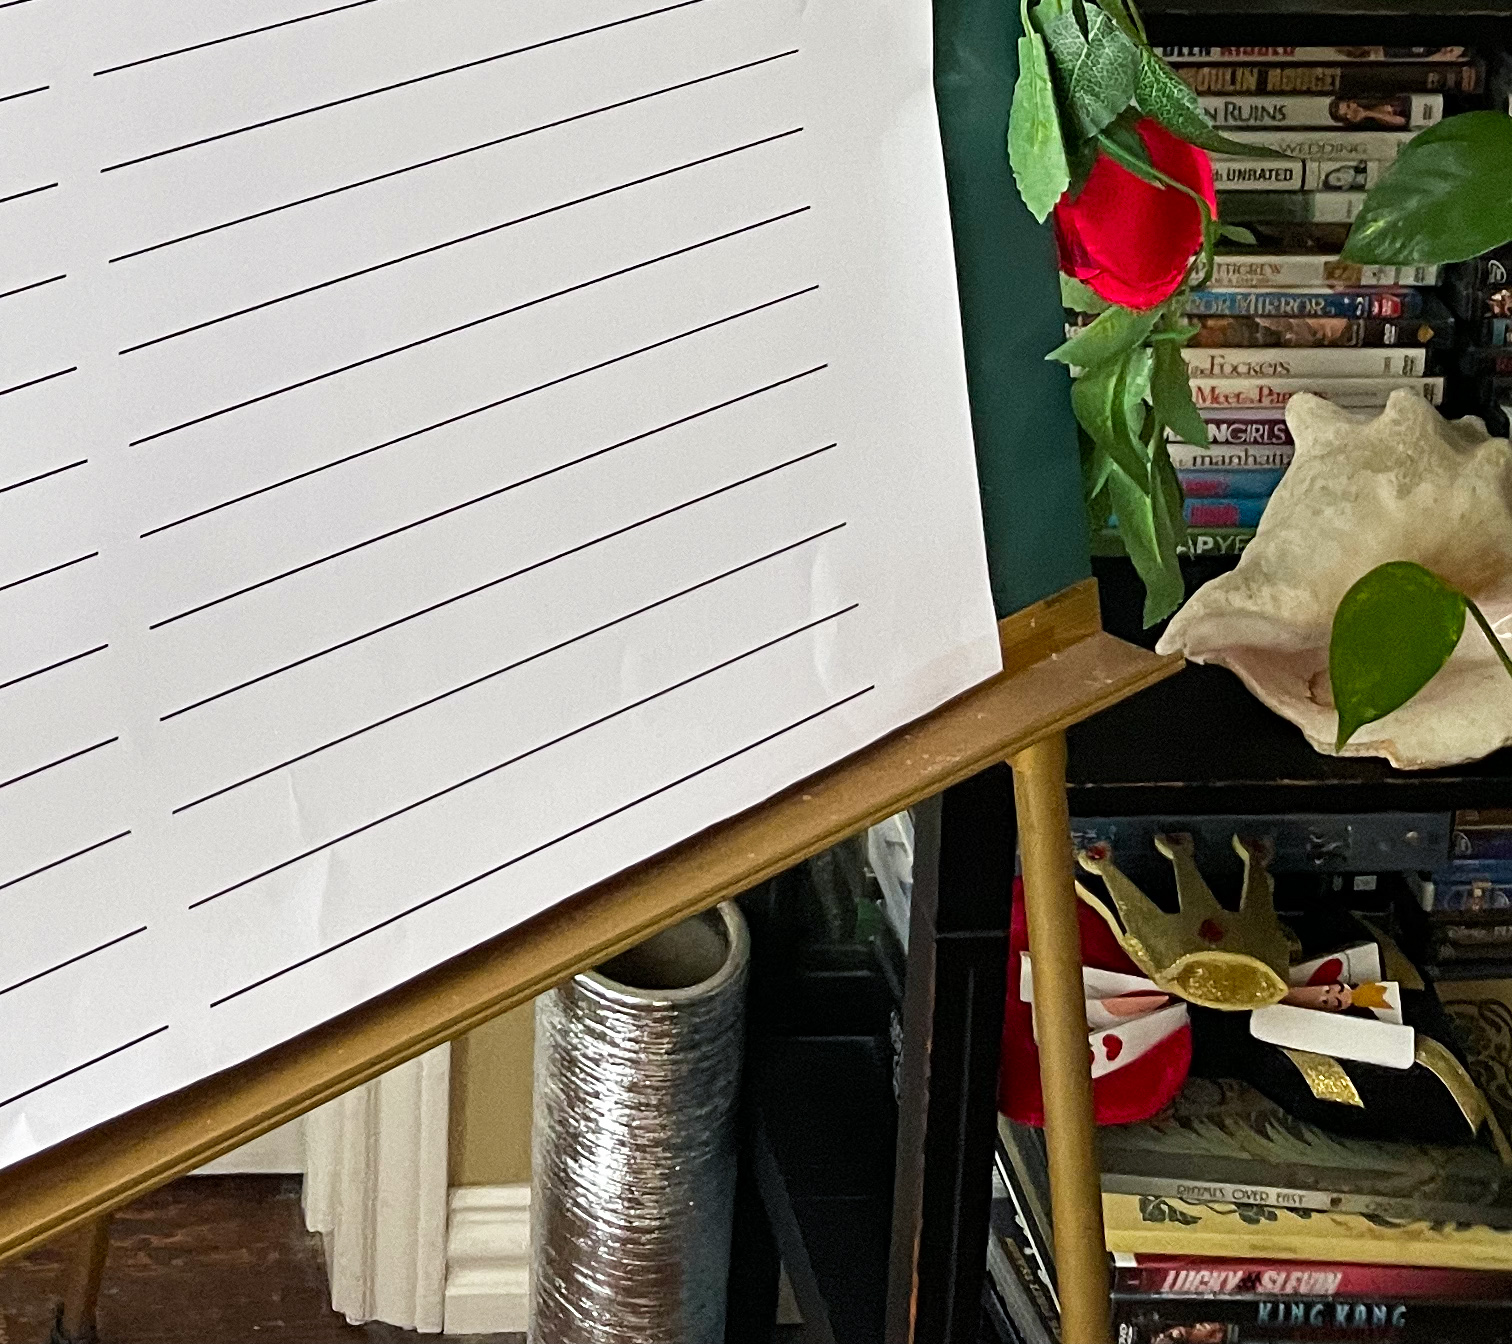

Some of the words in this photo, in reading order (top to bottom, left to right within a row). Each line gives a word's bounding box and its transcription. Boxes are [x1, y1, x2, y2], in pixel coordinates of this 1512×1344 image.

[1224, 101, 1287, 123] RUINS
[1226, 167, 1294, 183] UNRATED
[1232, 1188, 1269, 1203] OVER
[1161, 1270, 1244, 1295] LUCKY
[1255, 1270, 1343, 1295] SLEVIN
[1258, 1302, 1323, 1327] KING
[1334, 1302, 1407, 1328] KONG
